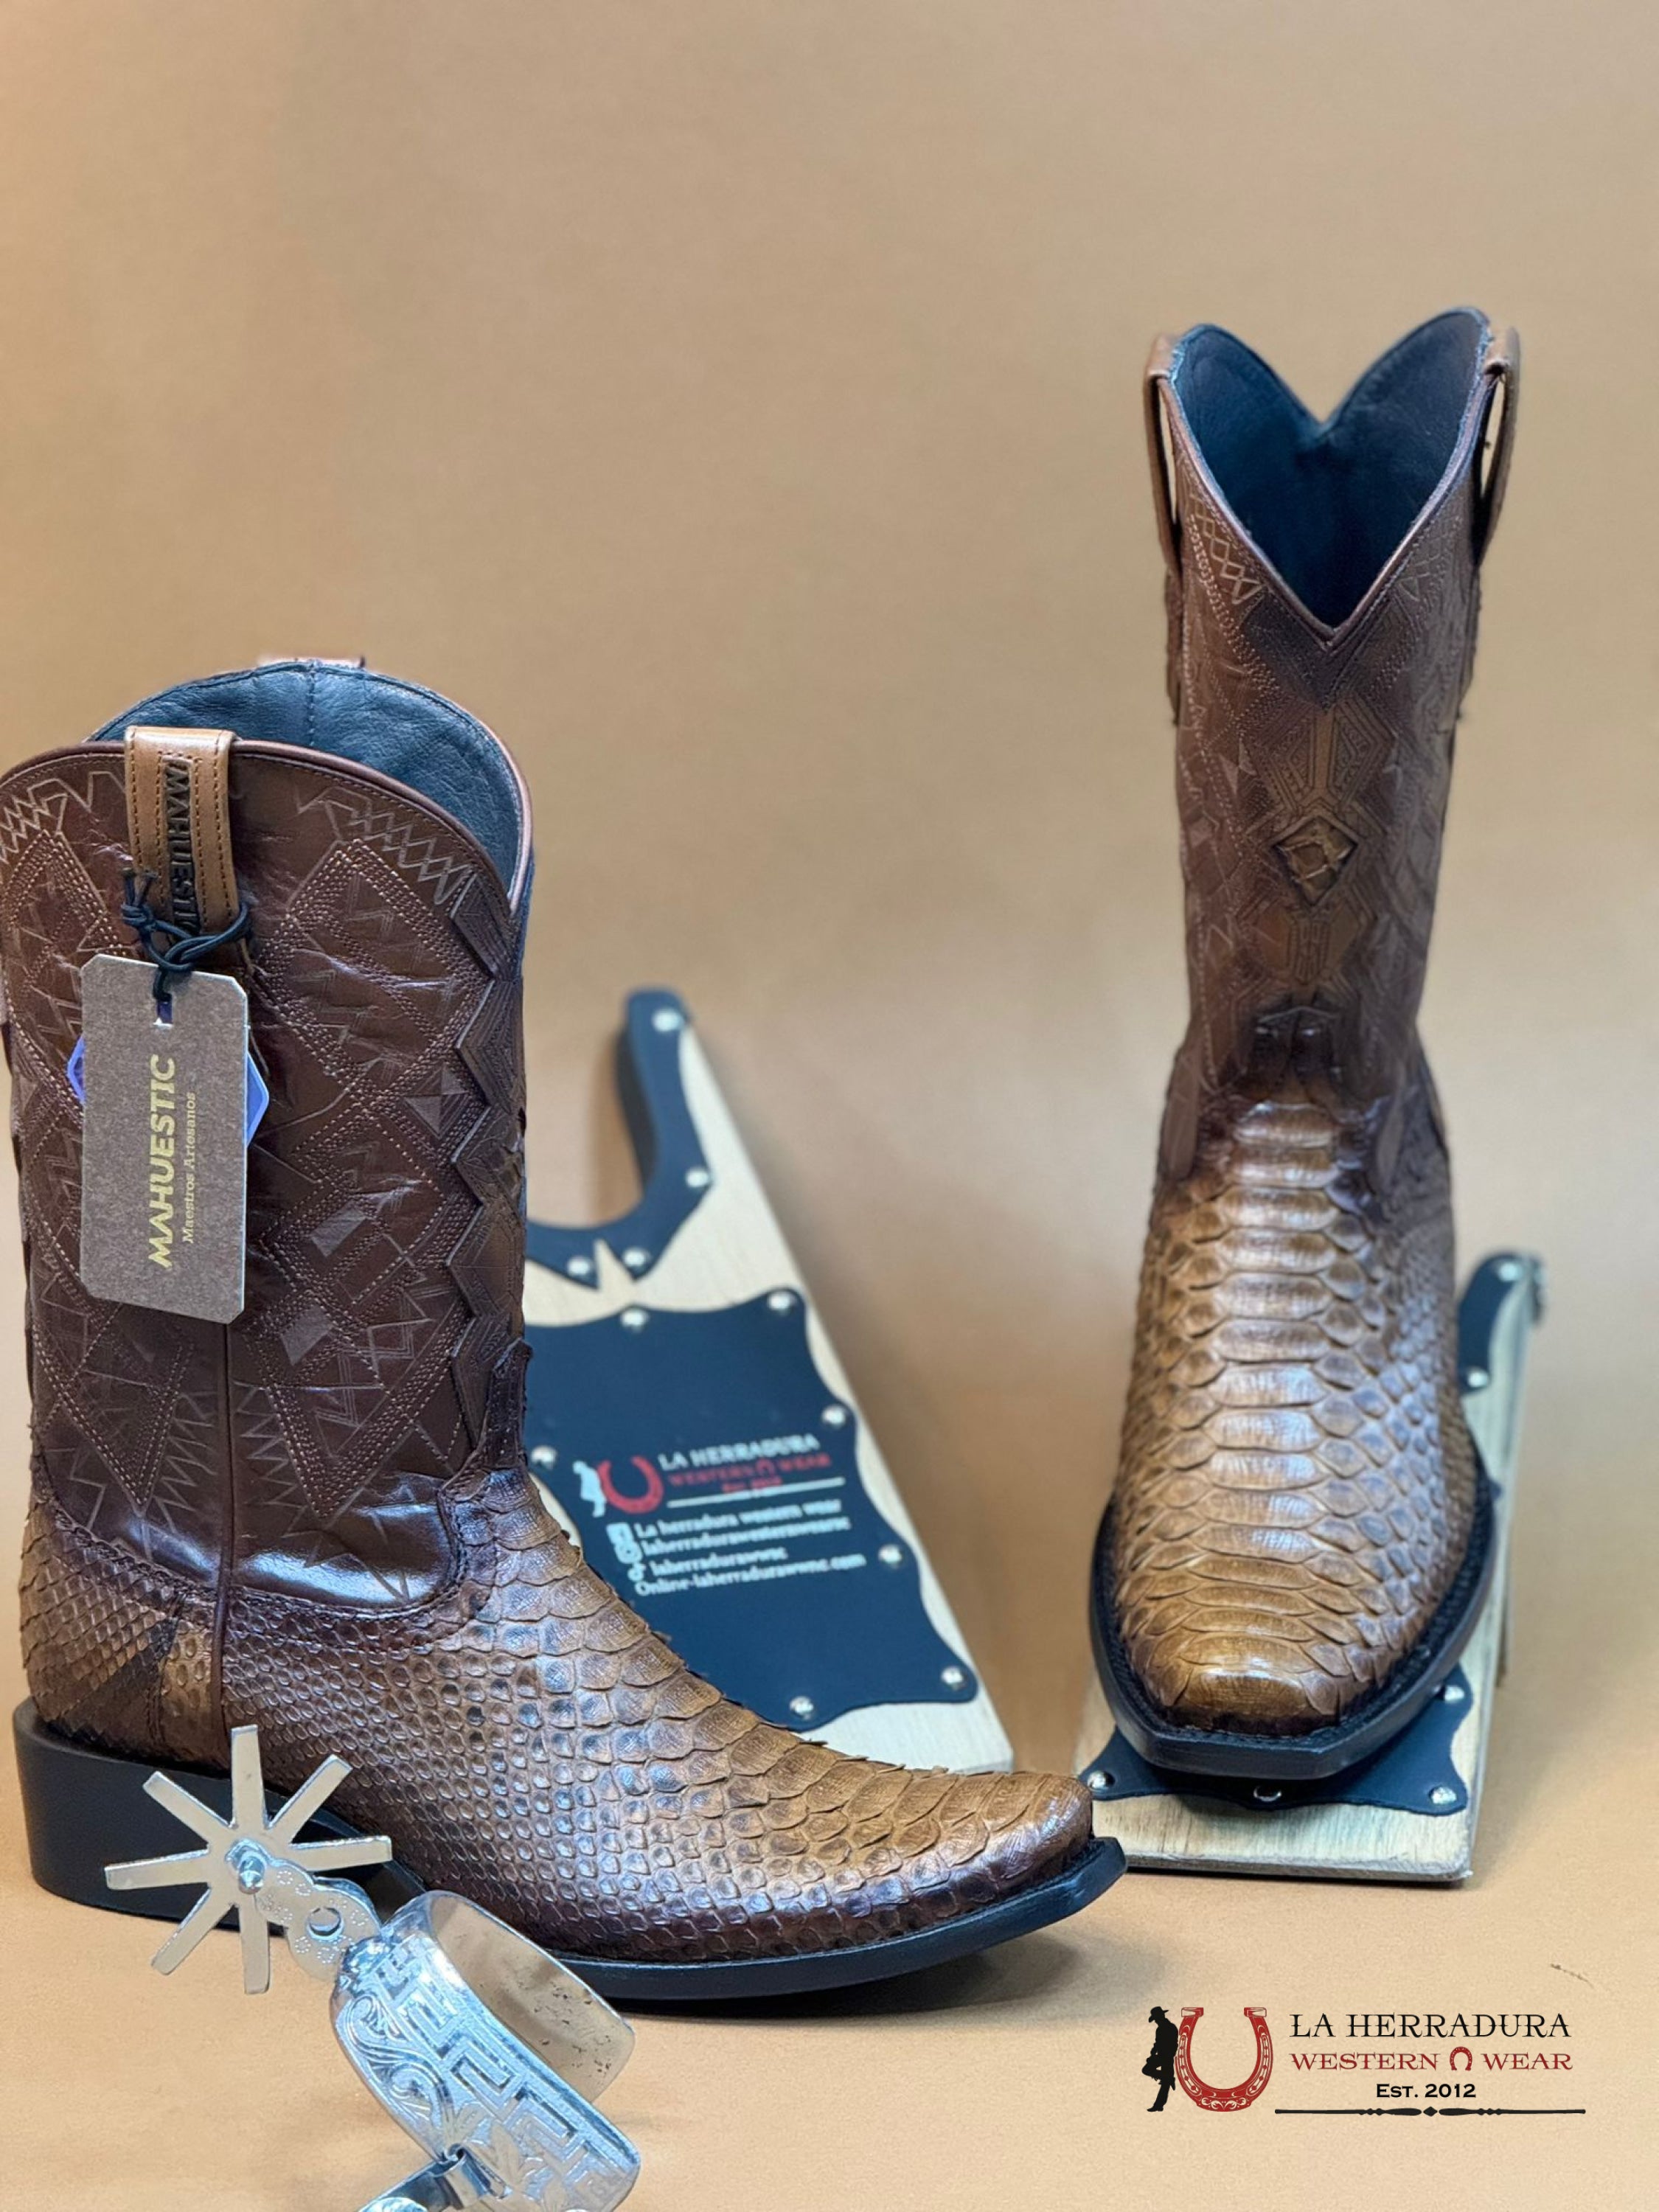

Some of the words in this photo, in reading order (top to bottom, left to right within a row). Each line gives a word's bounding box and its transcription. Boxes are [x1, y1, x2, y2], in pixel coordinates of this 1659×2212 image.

[147, 1053, 176, 1269] MAHUESTIC
[181, 1173, 195, 1245] Maestros
[658, 1452, 689, 1471] LA
[689, 1433, 820, 1467] HERRADURA
[636, 1523, 658, 1538] La
